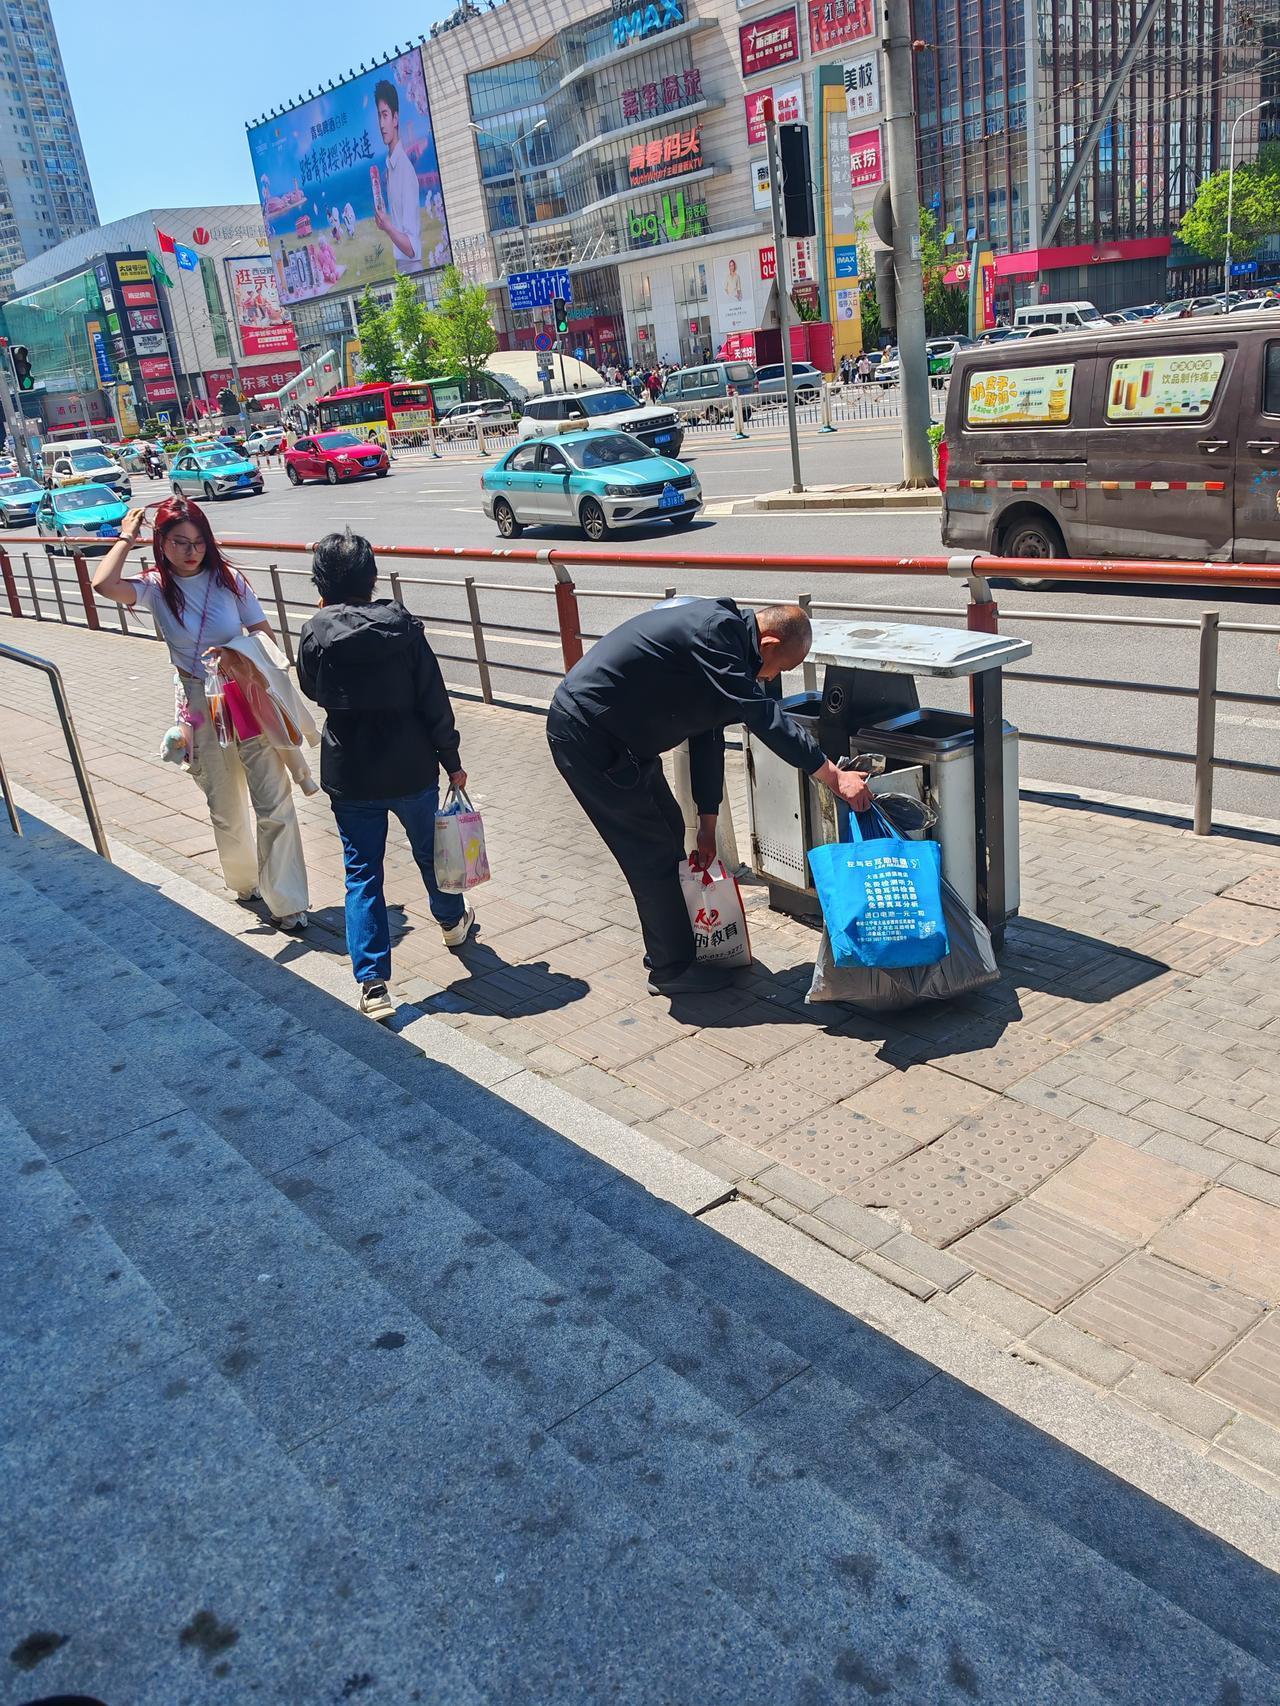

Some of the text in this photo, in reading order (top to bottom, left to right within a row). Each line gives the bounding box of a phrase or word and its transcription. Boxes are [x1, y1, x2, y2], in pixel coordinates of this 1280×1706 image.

[612, 0, 684, 45] IMAX
[629, 127, 700, 170] 青春码头
[836, 255, 855, 265] IMAX
[143, 313, 158, 322] KFC
[1161, 371, 1219, 385] 饮品制作痛点
[864, 879, 914, 888] 免费检测听力
